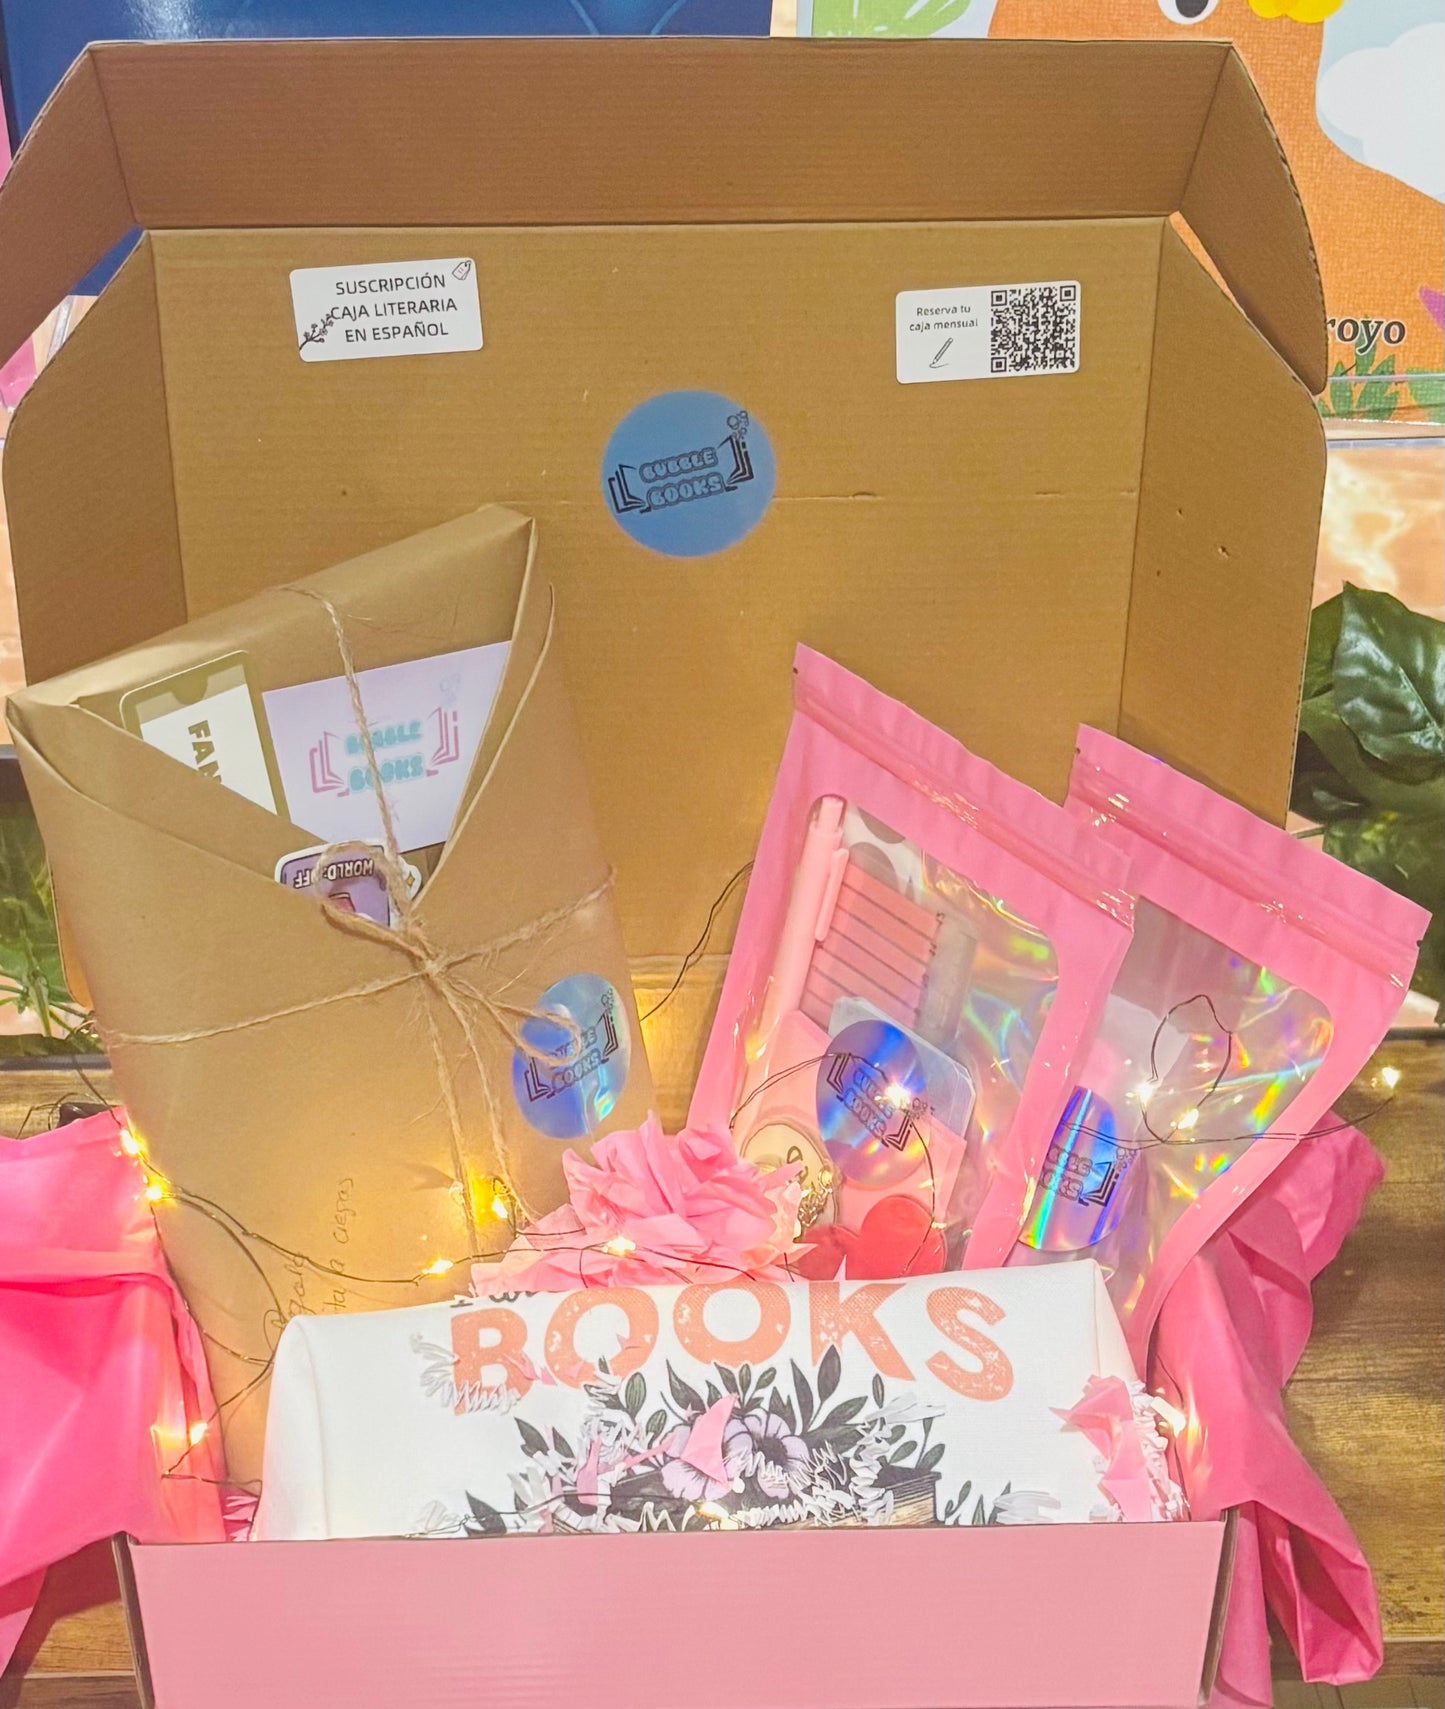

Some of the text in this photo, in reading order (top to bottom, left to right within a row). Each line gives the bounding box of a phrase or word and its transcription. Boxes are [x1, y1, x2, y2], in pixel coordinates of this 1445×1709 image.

[335, 272, 446, 296] SUSCRIPCIÓN
[330, 298, 458, 321] CAJA LITERARIA
[916, 304, 971, 317] Reserva tu
[345, 321, 449, 343] EN ESPAÑOL
[909, 318, 979, 333] caja mensual
[450, 1281, 1015, 1415] BOOKS
